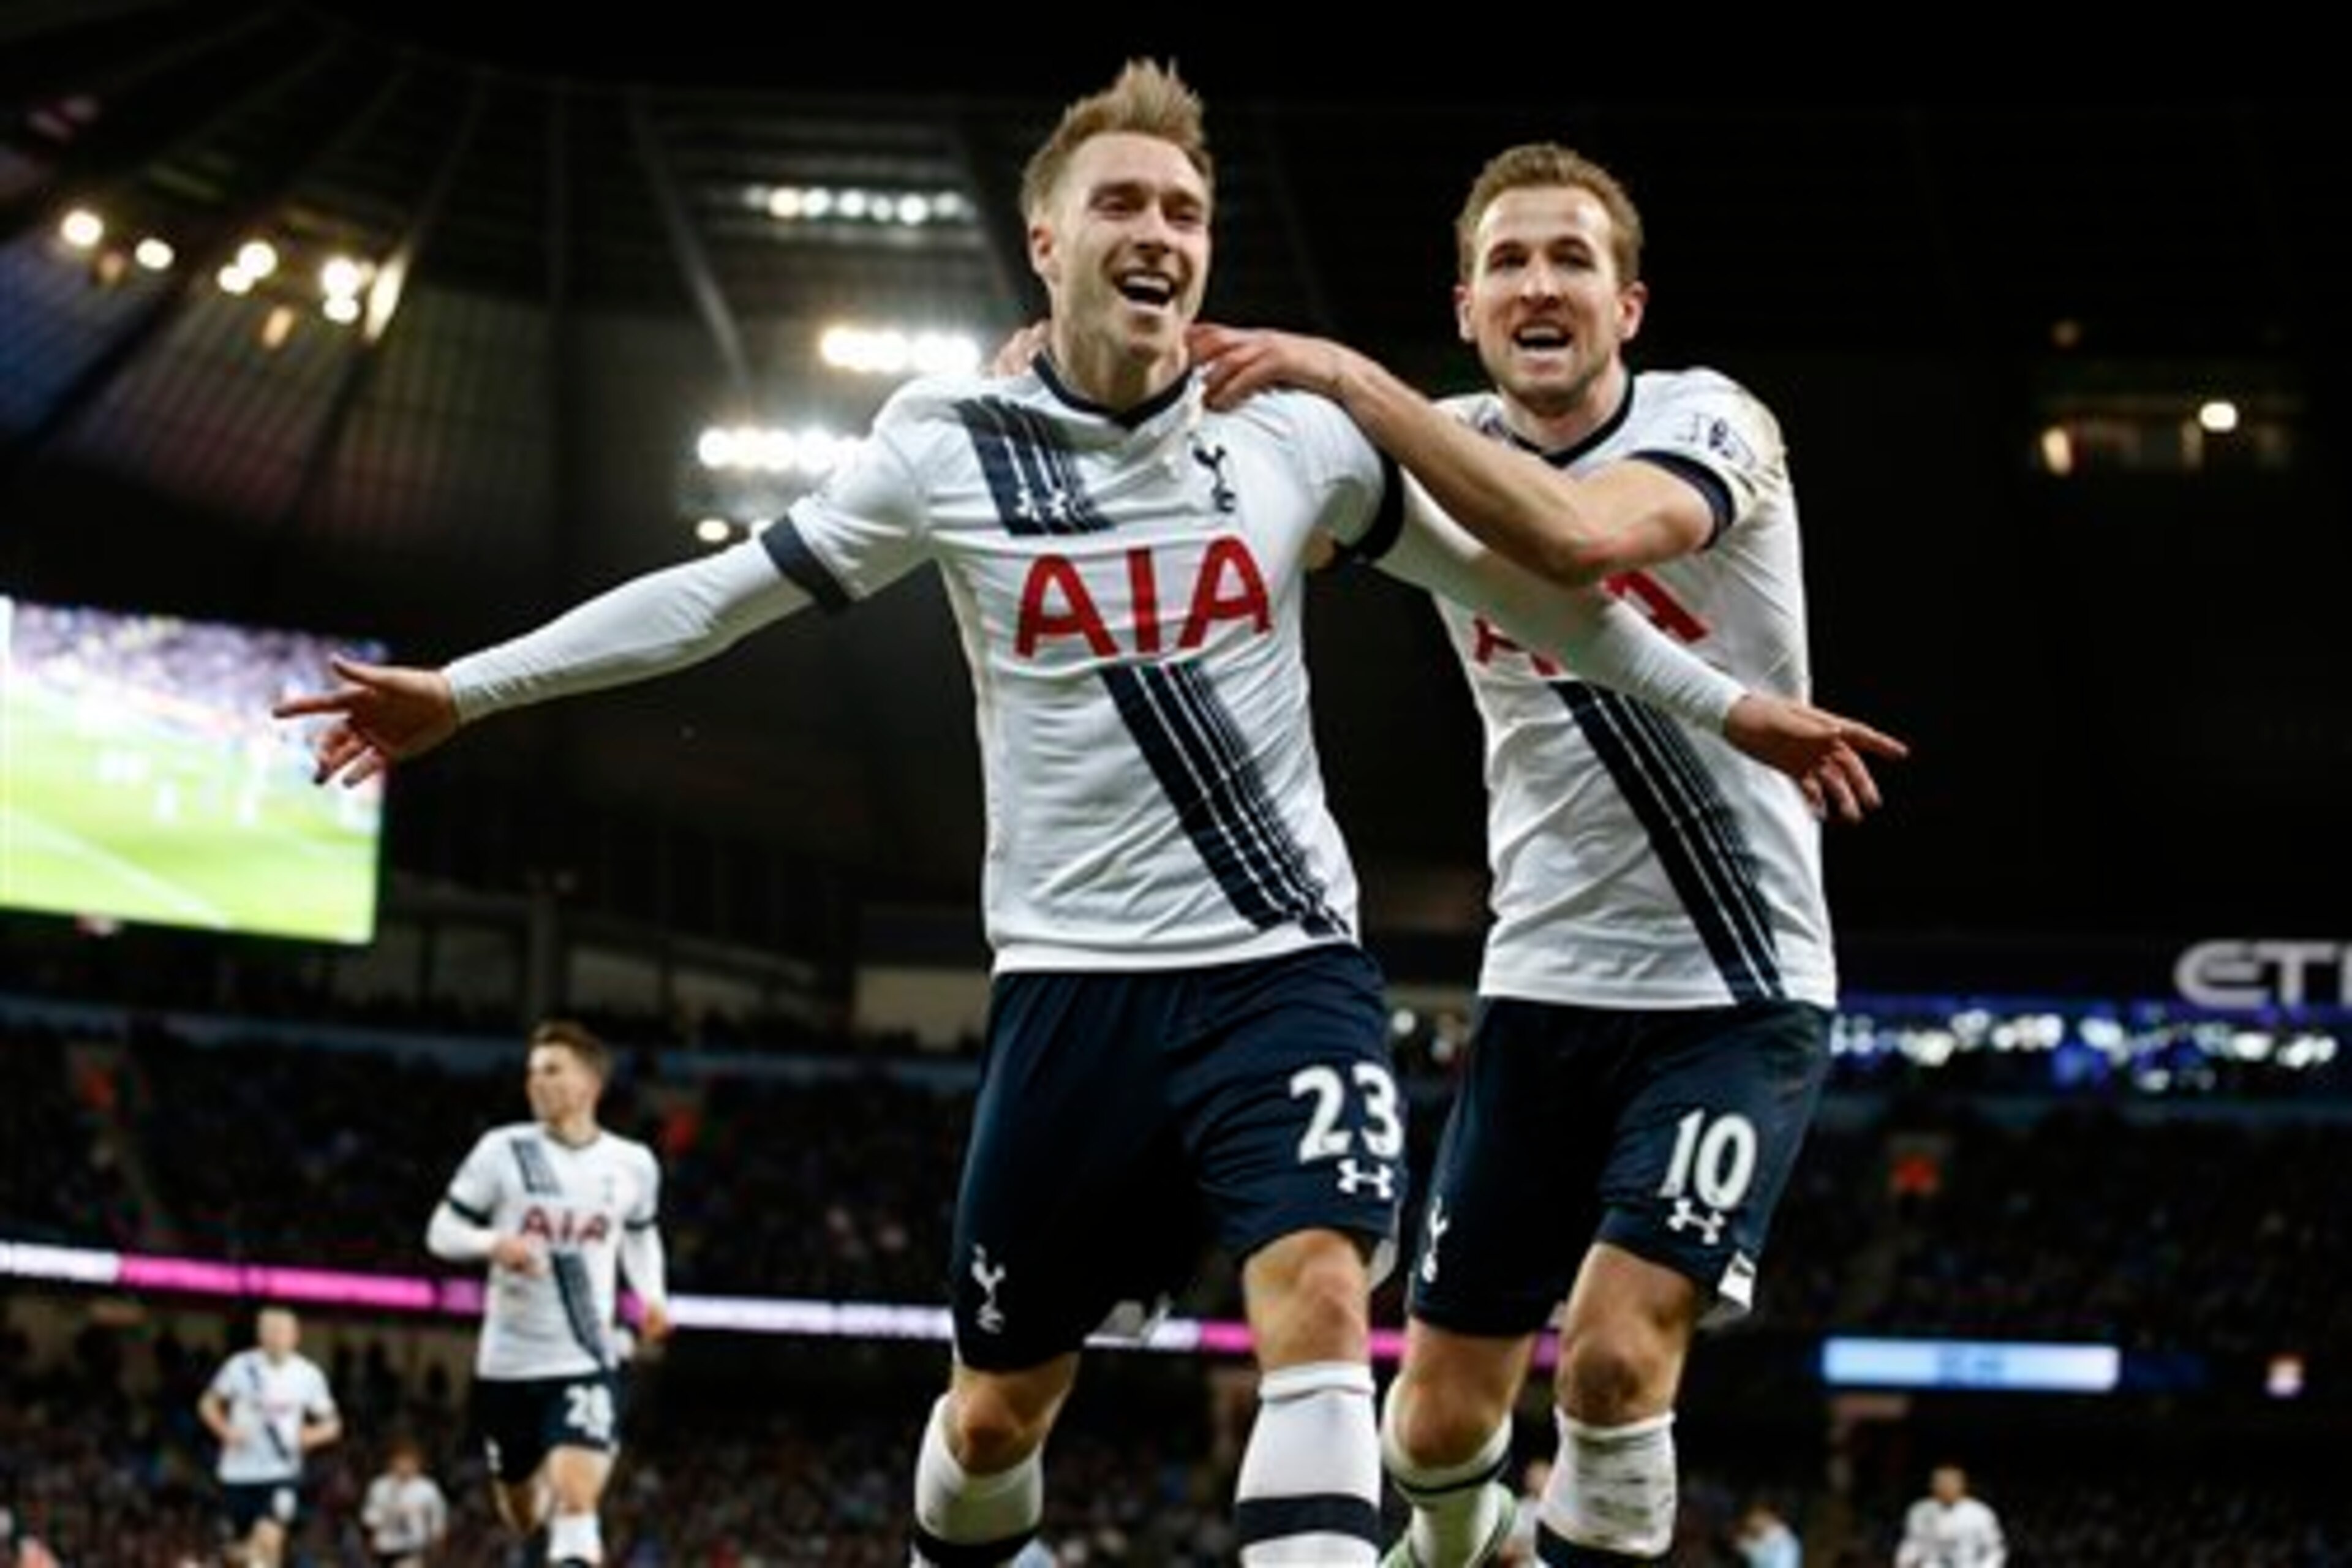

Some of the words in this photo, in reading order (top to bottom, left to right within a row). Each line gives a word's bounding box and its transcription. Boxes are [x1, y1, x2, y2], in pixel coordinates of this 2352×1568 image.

[1014, 535, 1273, 658] AIA
[1289, 1061, 1404, 1164] 23
[1659, 1109, 1758, 1210] 10
[521, 1204, 610, 1243] AIA
